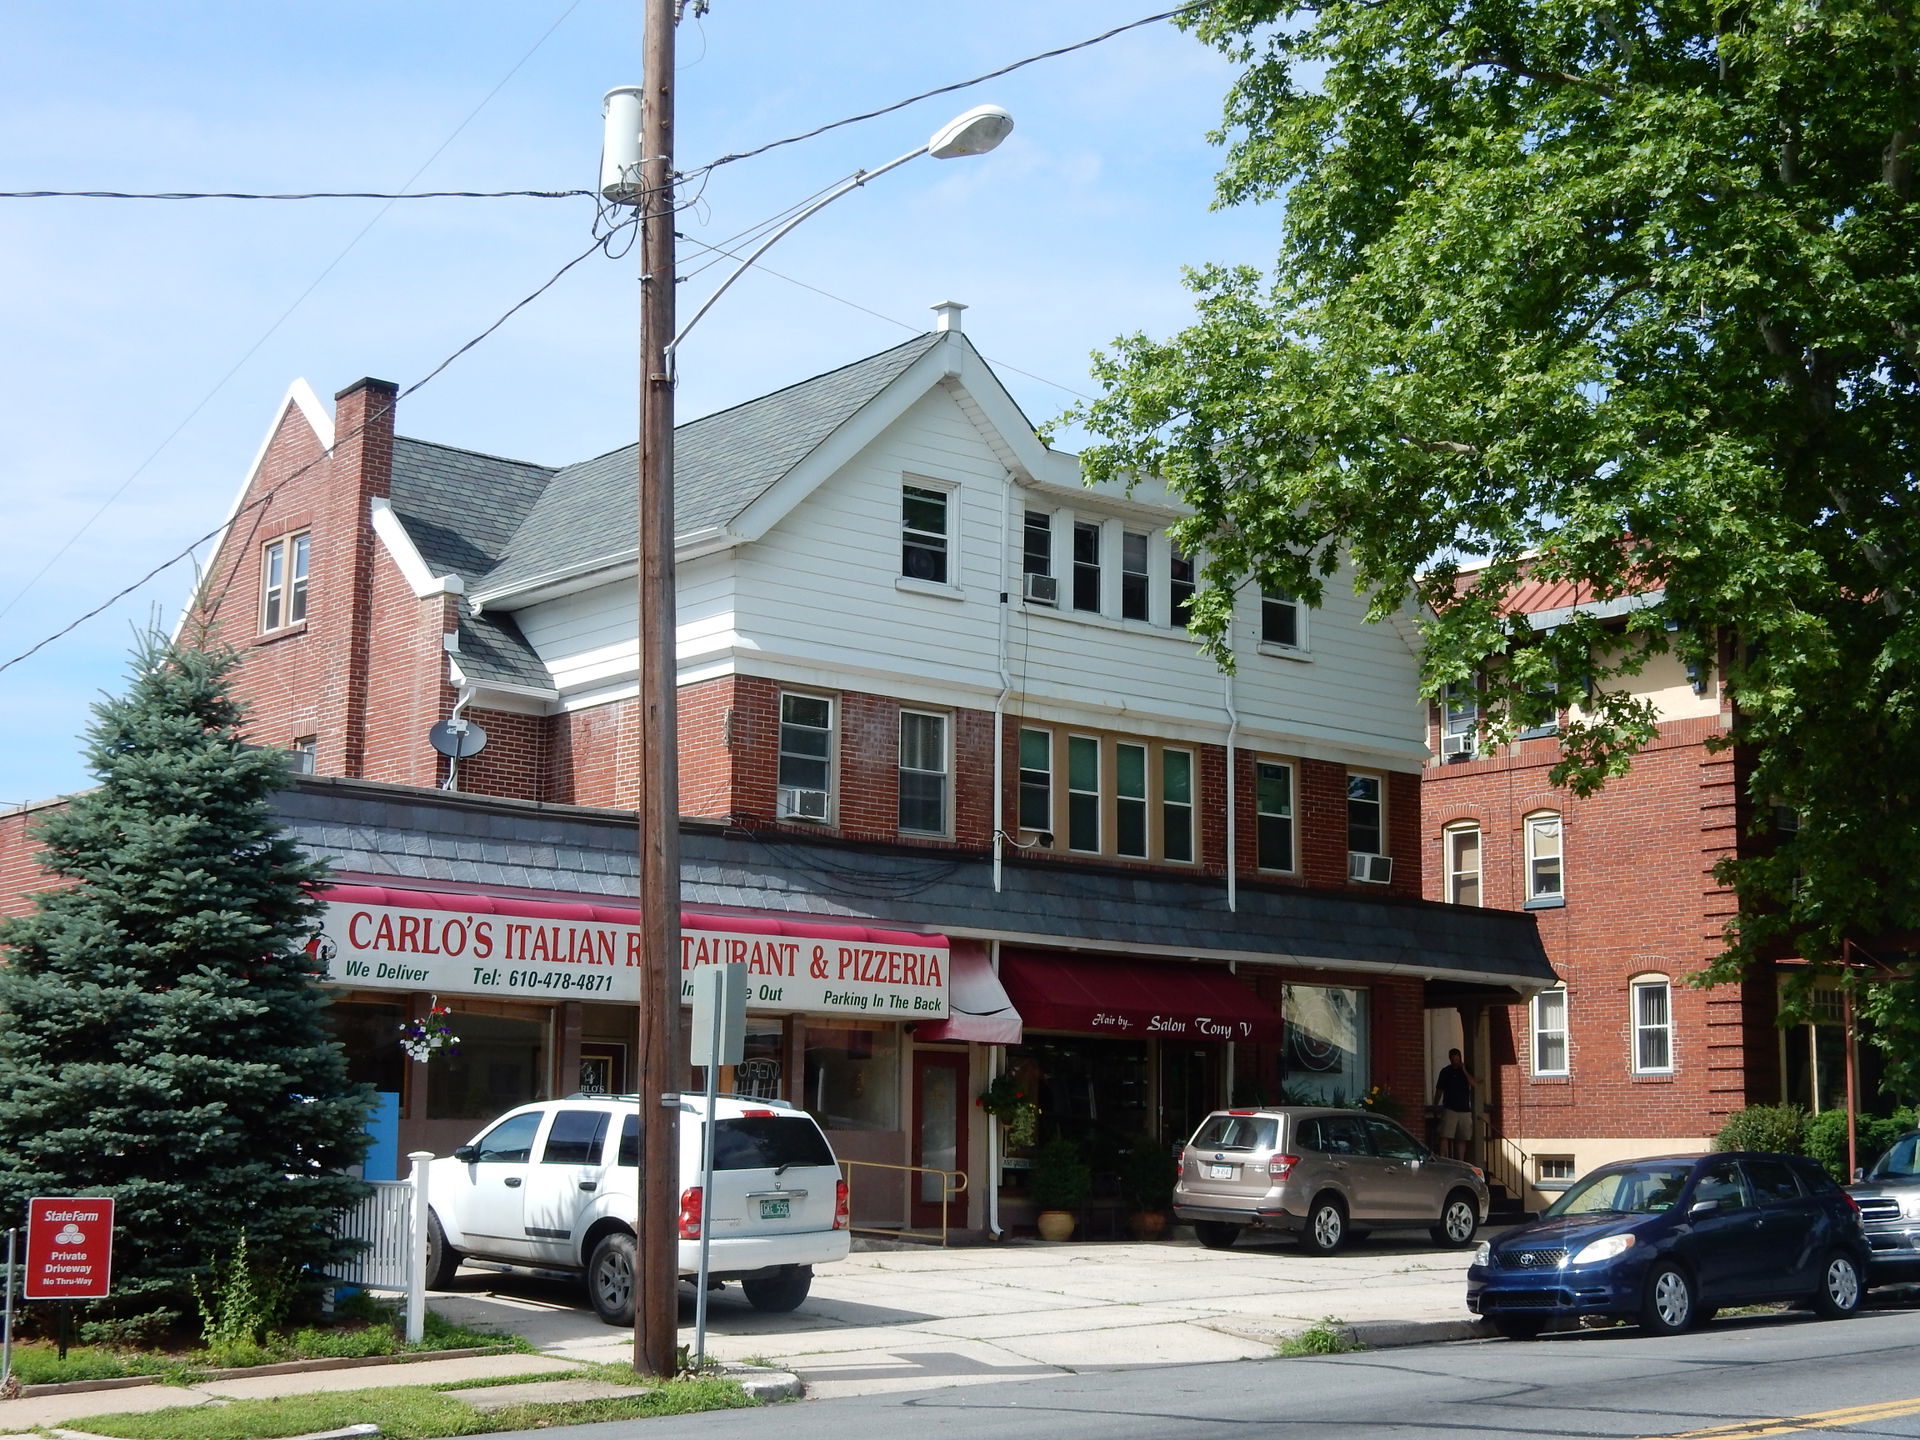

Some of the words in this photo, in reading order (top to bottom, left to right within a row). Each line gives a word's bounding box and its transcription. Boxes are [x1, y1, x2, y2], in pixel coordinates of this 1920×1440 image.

[348, 911, 493, 959] CARLO'S
[505, 923, 617, 966] ITALIAN
[625, 932, 800, 976] RTAURANT
[809, 945, 829, 979] &
[837, 947, 942, 987] PIZZERIA
[346, 960, 370, 978] We
[376, 962, 430, 982] Deliver
[472, 967, 502, 986] Tel:
[508, 970, 613, 992] 610-478-4871
[758, 984, 783, 1001] Out
[823, 990, 868, 1010] Parking
[872, 993, 884, 1008] In
[889, 994, 910, 1009] The
[913, 996, 942, 1012] Back
[1092, 1013, 1116, 1026] Hair
[1146, 1015, 1186, 1033] Salon
[1194, 1017, 1232, 1039] Tony
[1239, 1022, 1252, 1037] V
[737, 1061, 780, 1079] OPEN
[578, 1084, 605, 1093] RLO'S
[51, 1252, 87, 1260] Private
[45, 1264, 92, 1275] Driveway
[57, 1278, 93, 1286] Thru-Way
